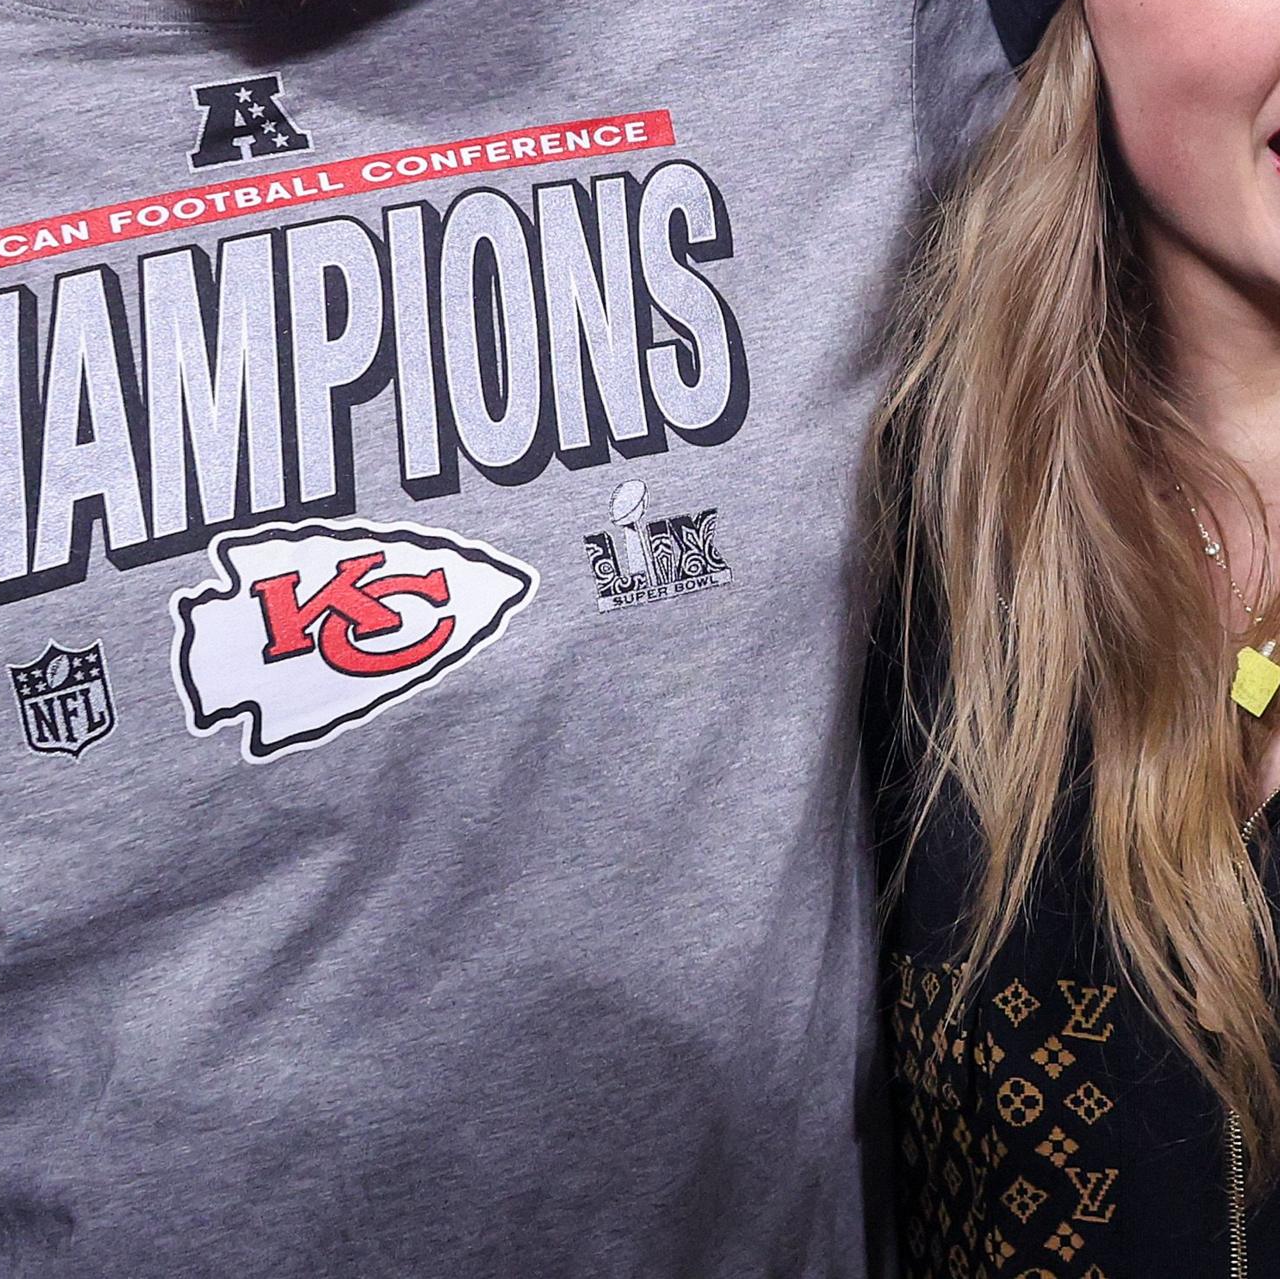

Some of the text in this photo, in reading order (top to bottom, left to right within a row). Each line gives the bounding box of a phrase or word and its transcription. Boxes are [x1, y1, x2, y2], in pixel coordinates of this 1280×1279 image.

[109, 172, 345, 234] FOOTBALL
[361, 120, 648, 183] CONFERENCE
[249, 550, 457, 679] KC
[611, 576, 719, 607] SUPER BOWL
[28, 684, 107, 745] NFL
